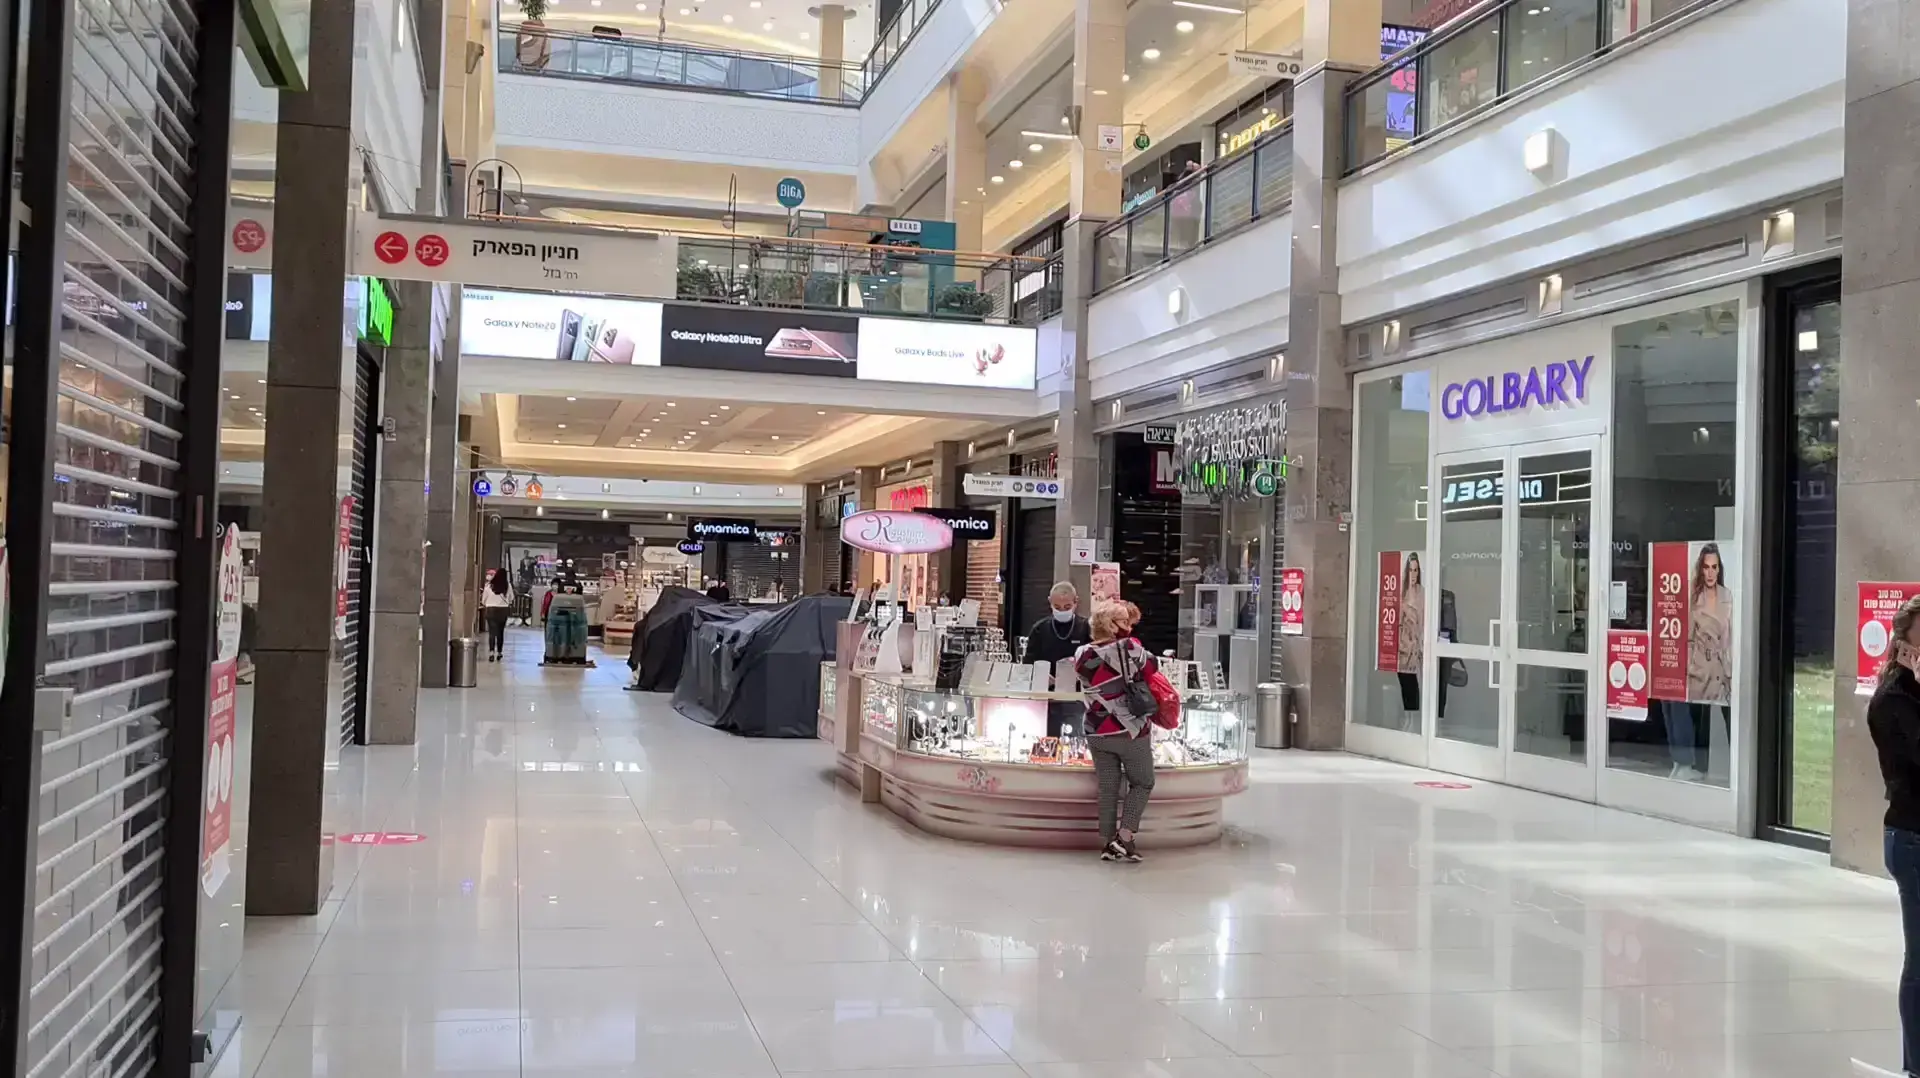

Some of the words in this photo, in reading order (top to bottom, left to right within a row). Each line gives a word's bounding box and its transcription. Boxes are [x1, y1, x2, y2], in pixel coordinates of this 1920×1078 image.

[780, 184, 802, 199] BIGA
[894, 220, 918, 231] BREAD
[473, 239, 536, 257] הפארק
[541, 246, 579, 262] חניון
[543, 266, 561, 280] בזל
[484, 318, 520, 328] Galaxy
[521, 321, 556, 330] Note20
[671, 329, 706, 343] Galaxy
[706, 332, 739, 345] Note20
[740, 333, 762, 346] Ultra
[894, 346, 926, 359] Galaxy
[927, 348, 947, 358] Buds
[949, 350, 965, 359] Live
[1442, 355, 1595, 420] GOLBARY
[1147, 427, 1174, 441] יציאה
[694, 522, 749, 535] dynamica
[1384, 575, 1396, 591] 30
[1660, 573, 1681, 594] 30
[1383, 608, 1396, 624] 20
[1660, 617, 1681, 639] 20
